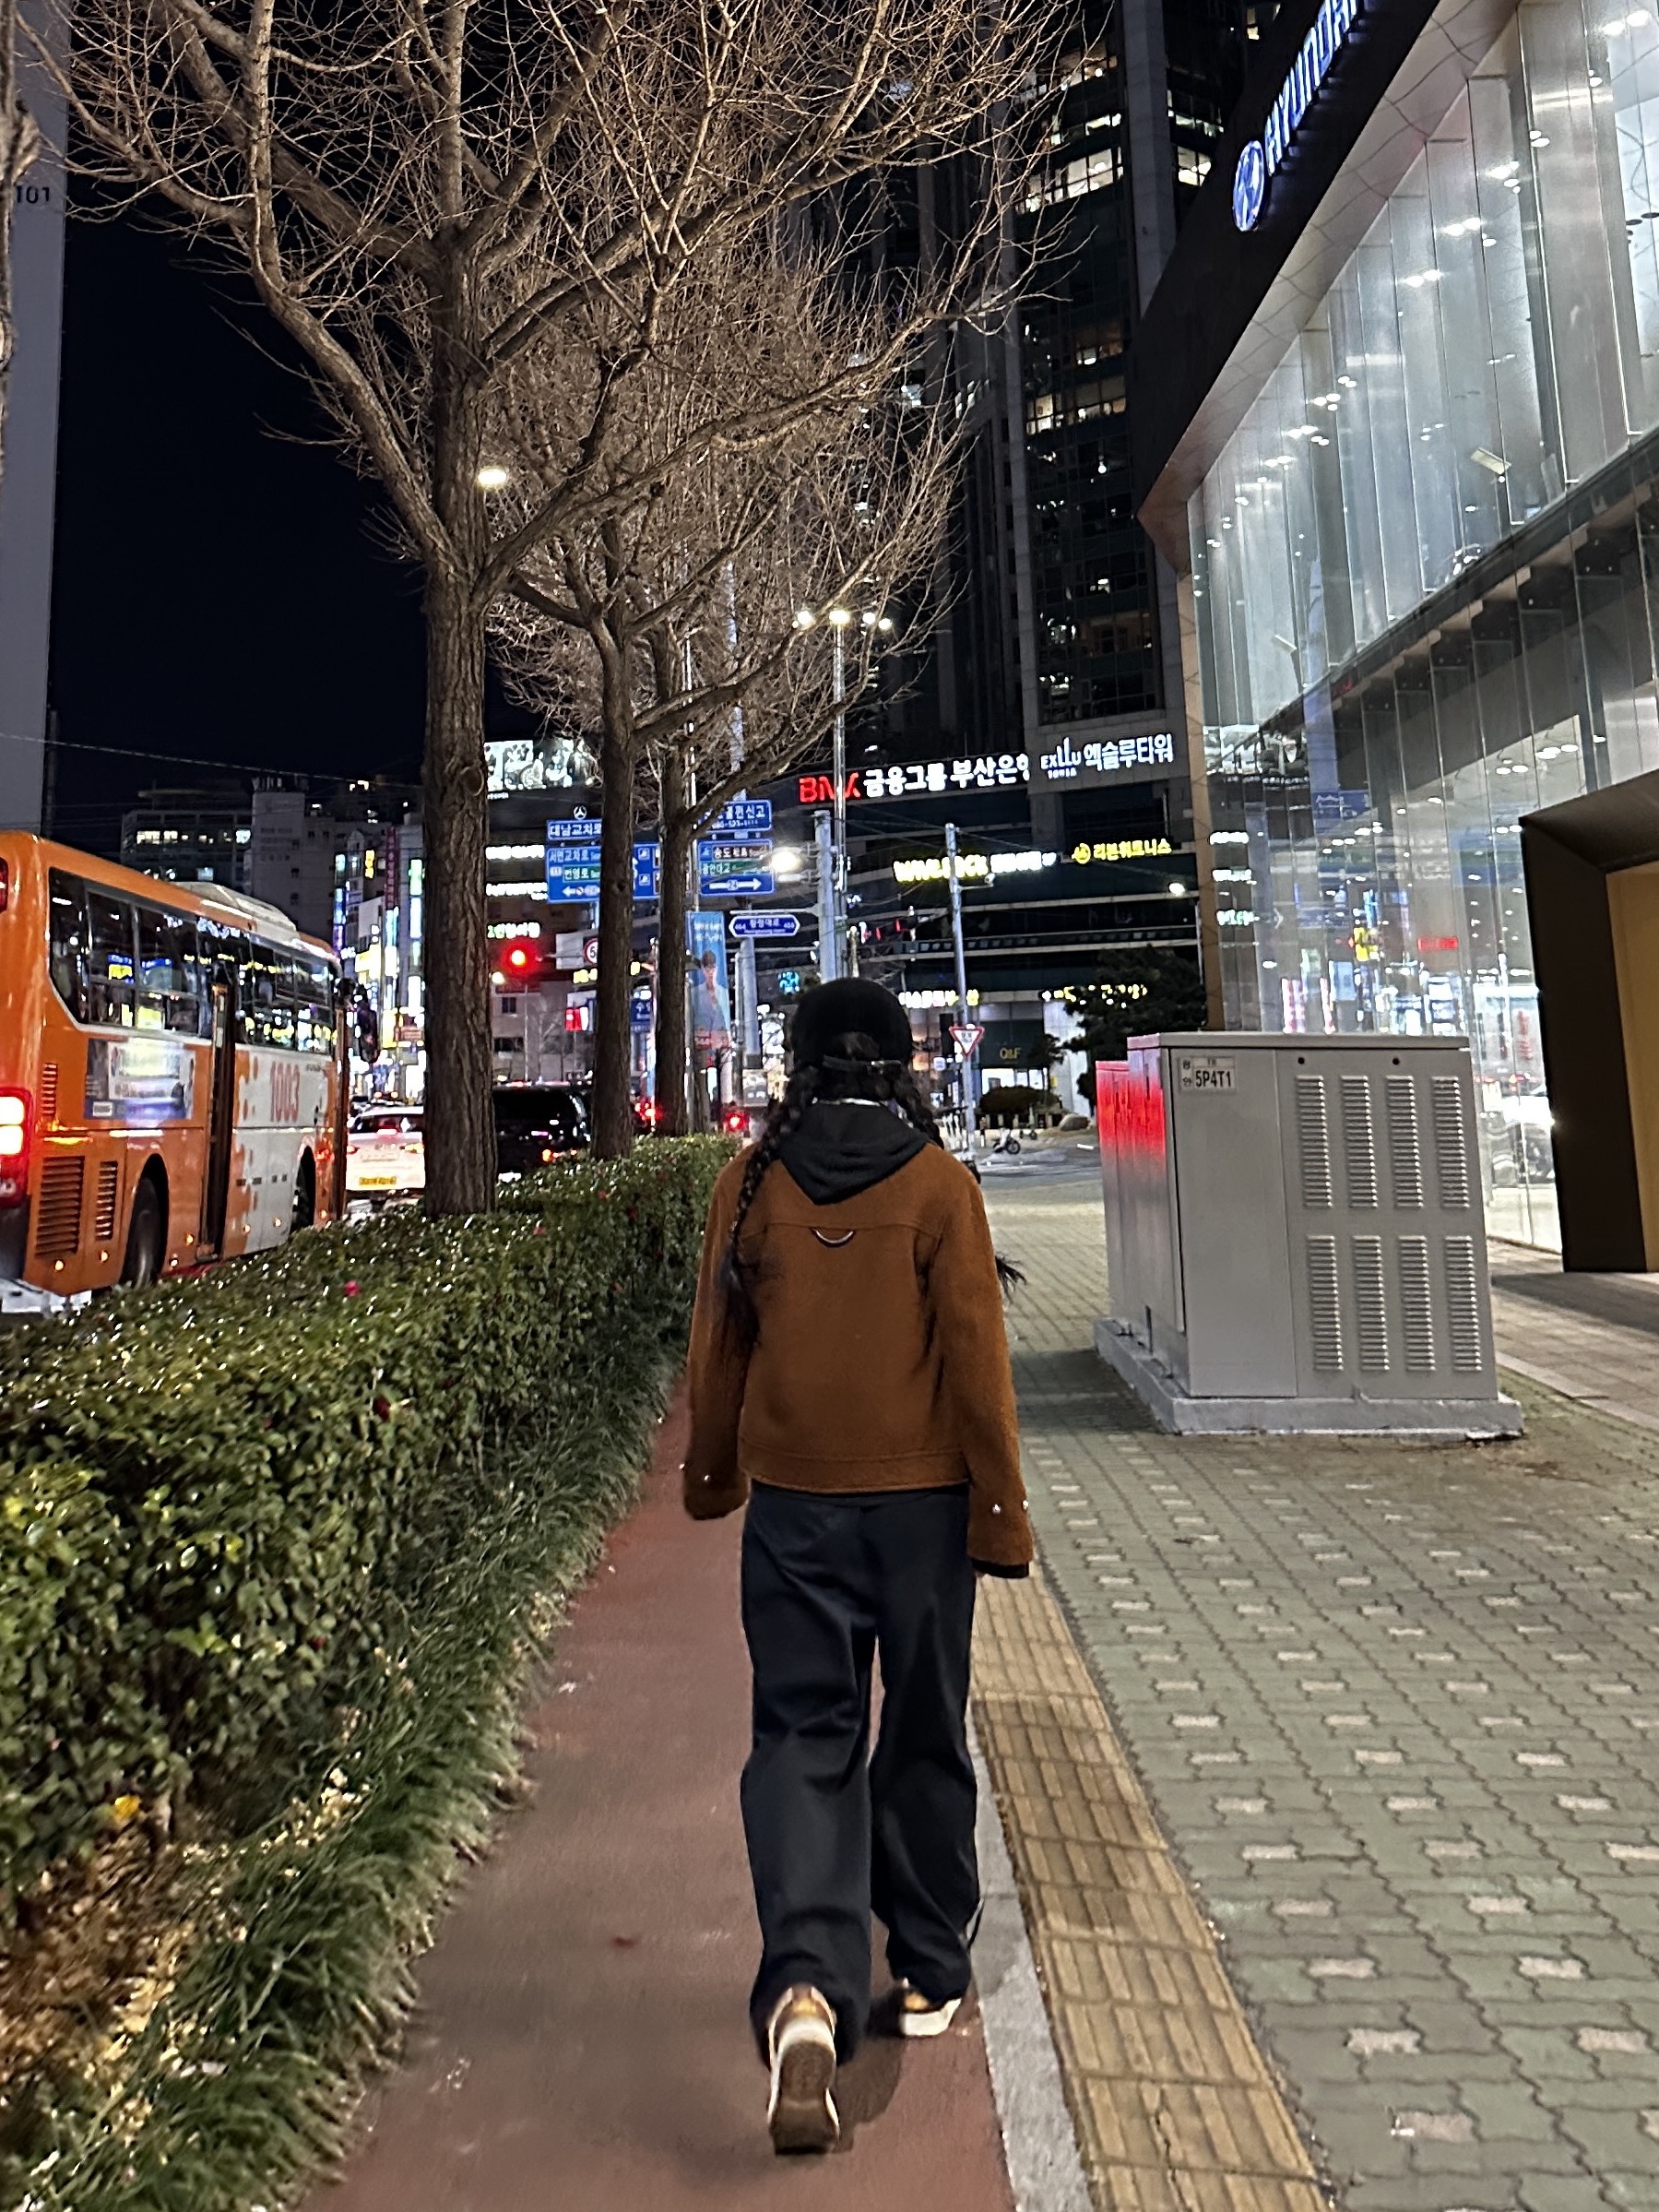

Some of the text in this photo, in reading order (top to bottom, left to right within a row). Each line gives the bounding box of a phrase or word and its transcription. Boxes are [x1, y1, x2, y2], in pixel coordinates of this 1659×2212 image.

[1264, 0, 1357, 177] HYUNDA
[16, 185, 51, 204] 101
[1083, 733, 1174, 771] 엑슬루타워
[863, 765, 948, 799] 금융그룹
[550, 822, 602, 837] 대남교차로
[269, 1060, 301, 1124] 1003
[1195, 1069, 1232, 1088] 5P4T1
